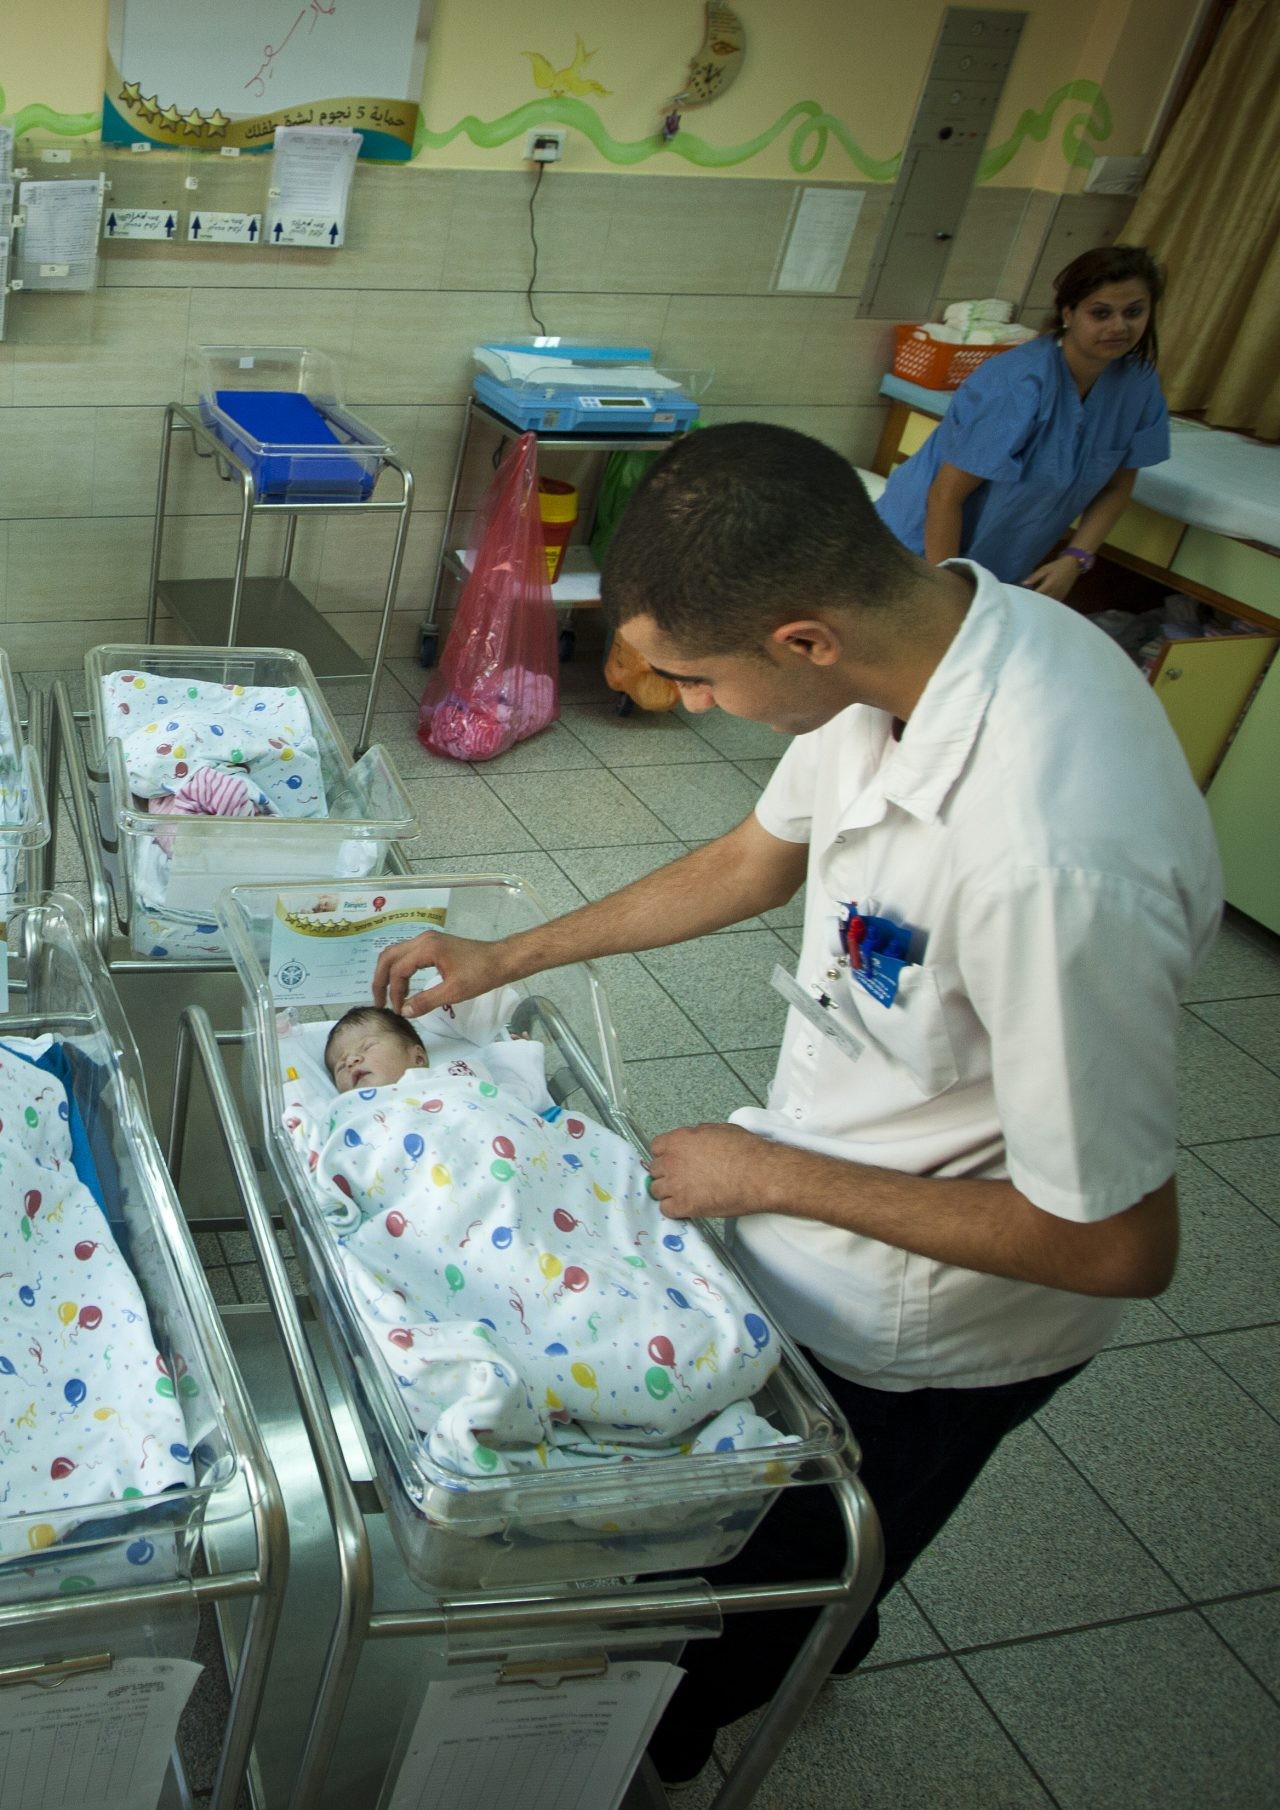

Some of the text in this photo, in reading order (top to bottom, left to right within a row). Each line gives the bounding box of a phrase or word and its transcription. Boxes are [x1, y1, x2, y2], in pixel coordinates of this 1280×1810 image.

[320, 106, 351, 126] نجوم
[356, 106, 365, 120] 5
[370, 106, 406, 127] حماية
